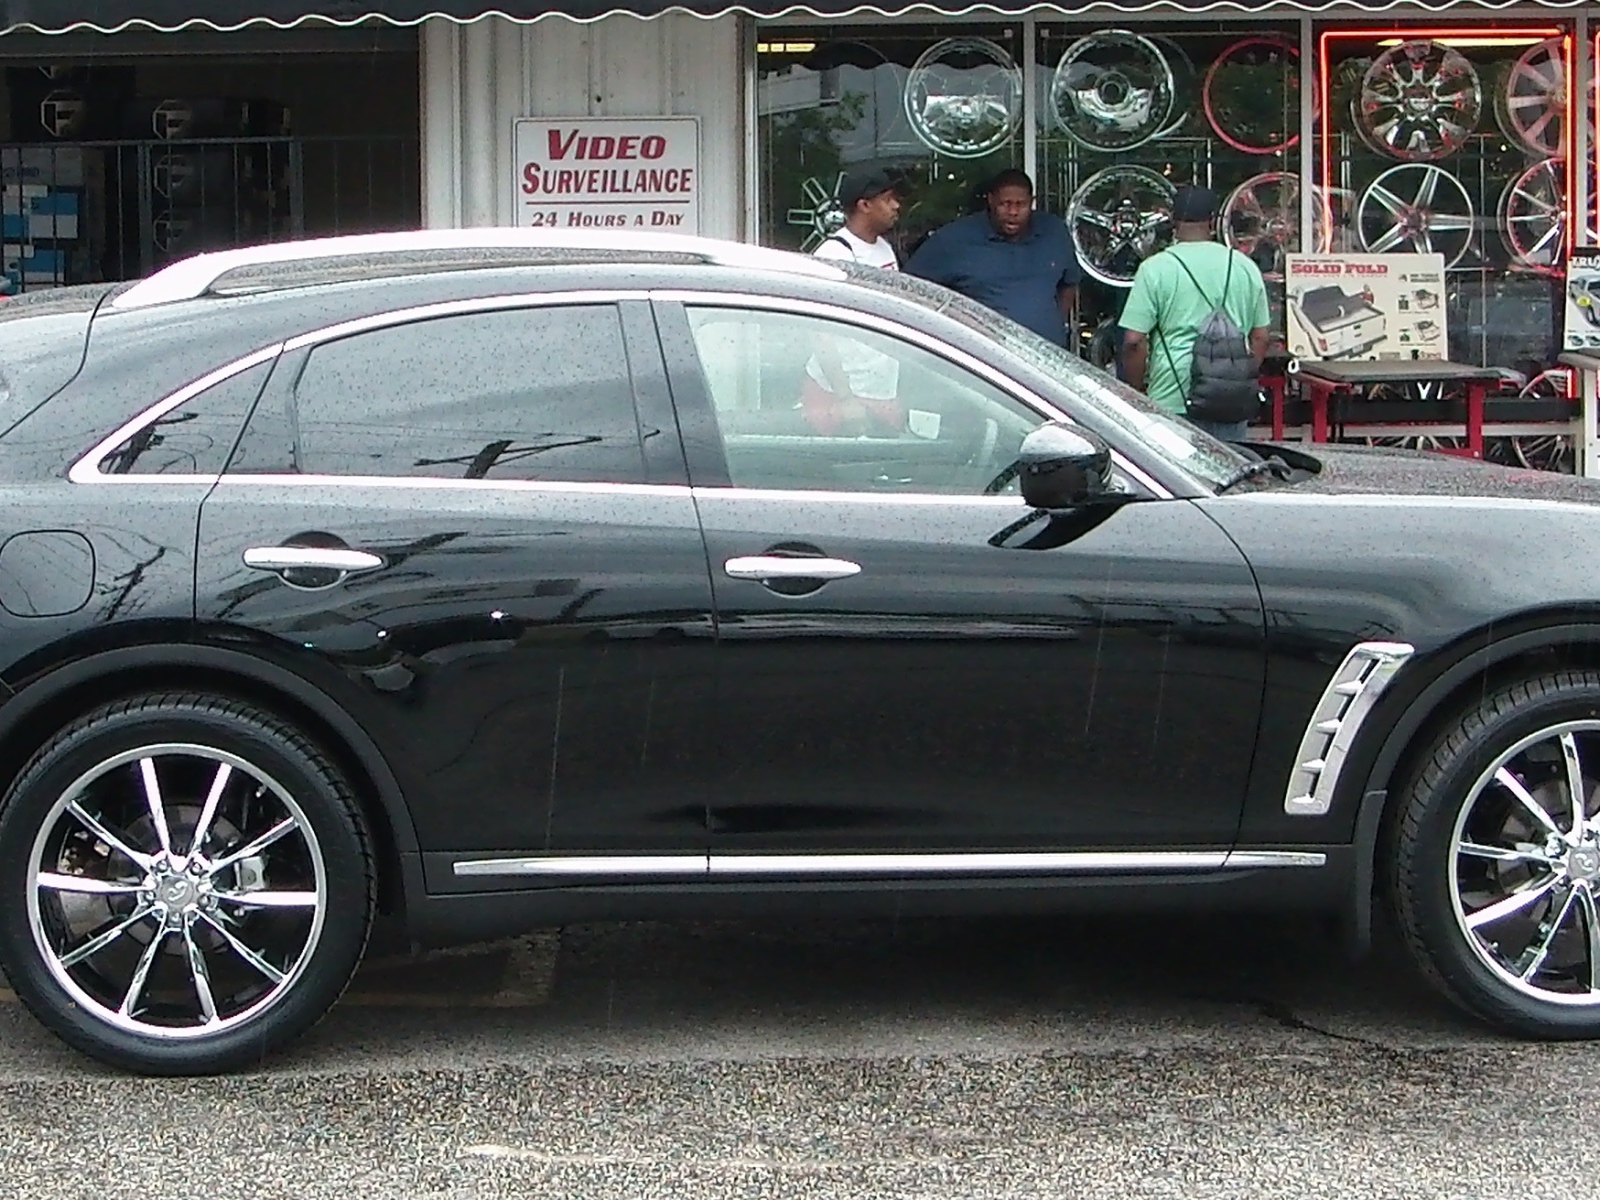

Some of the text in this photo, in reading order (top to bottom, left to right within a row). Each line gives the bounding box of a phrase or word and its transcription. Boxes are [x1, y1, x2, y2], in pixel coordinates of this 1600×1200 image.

[547, 129, 667, 160] VIDEO
[522, 162, 693, 194] SURVEILLANCE
[532, 211, 685, 227] 24 HOURS A DAY
[1291, 264, 1389, 274] SOLID FOLD
